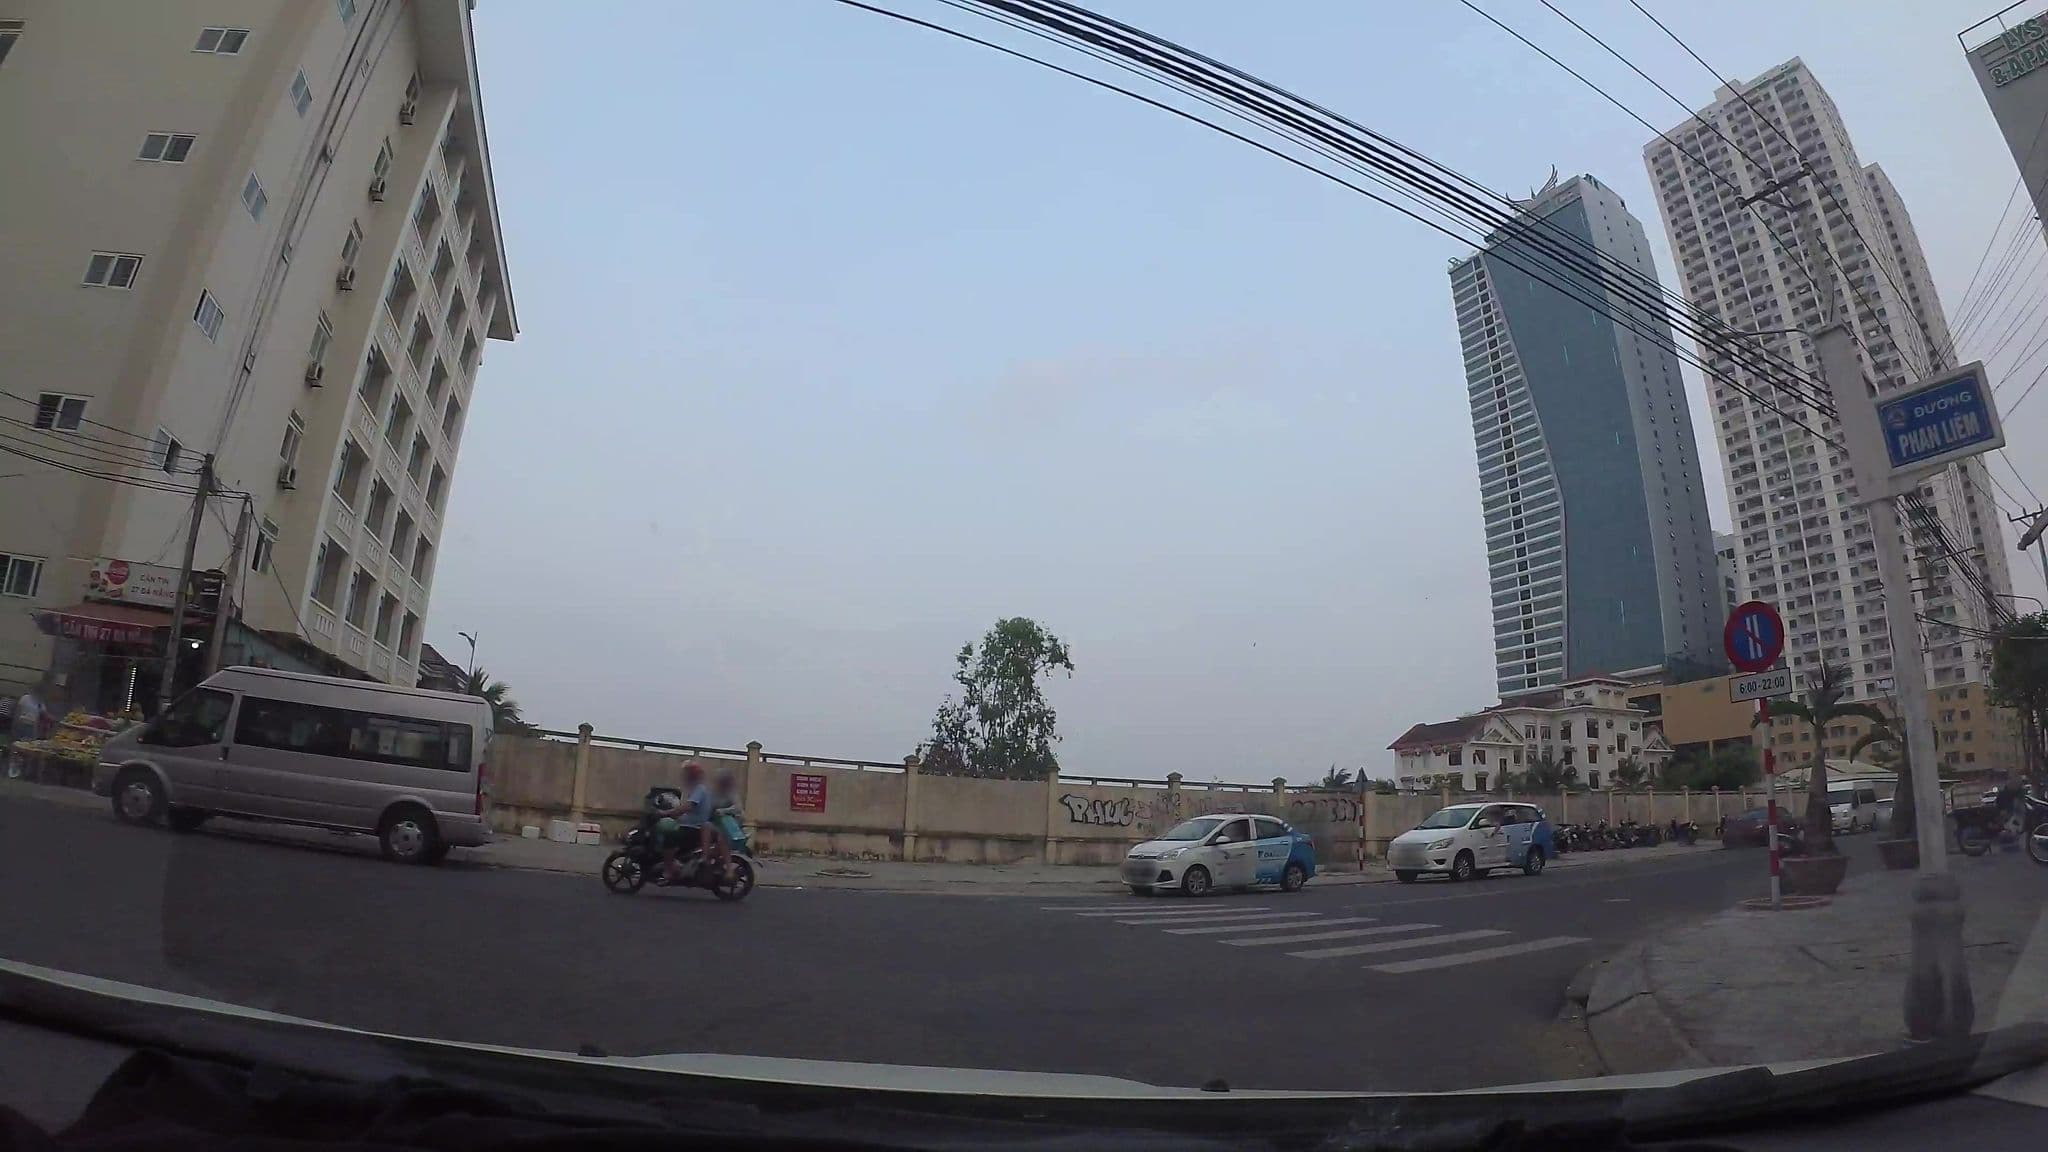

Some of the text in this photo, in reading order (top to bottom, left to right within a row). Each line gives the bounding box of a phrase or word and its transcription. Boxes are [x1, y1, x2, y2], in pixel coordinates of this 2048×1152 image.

[1913, 390, 1973, 418] ĐƯỜNG
[1898, 424, 1942, 458] PHAN
[131, 585, 140, 594] 27
[100, 627, 112, 641] 27
